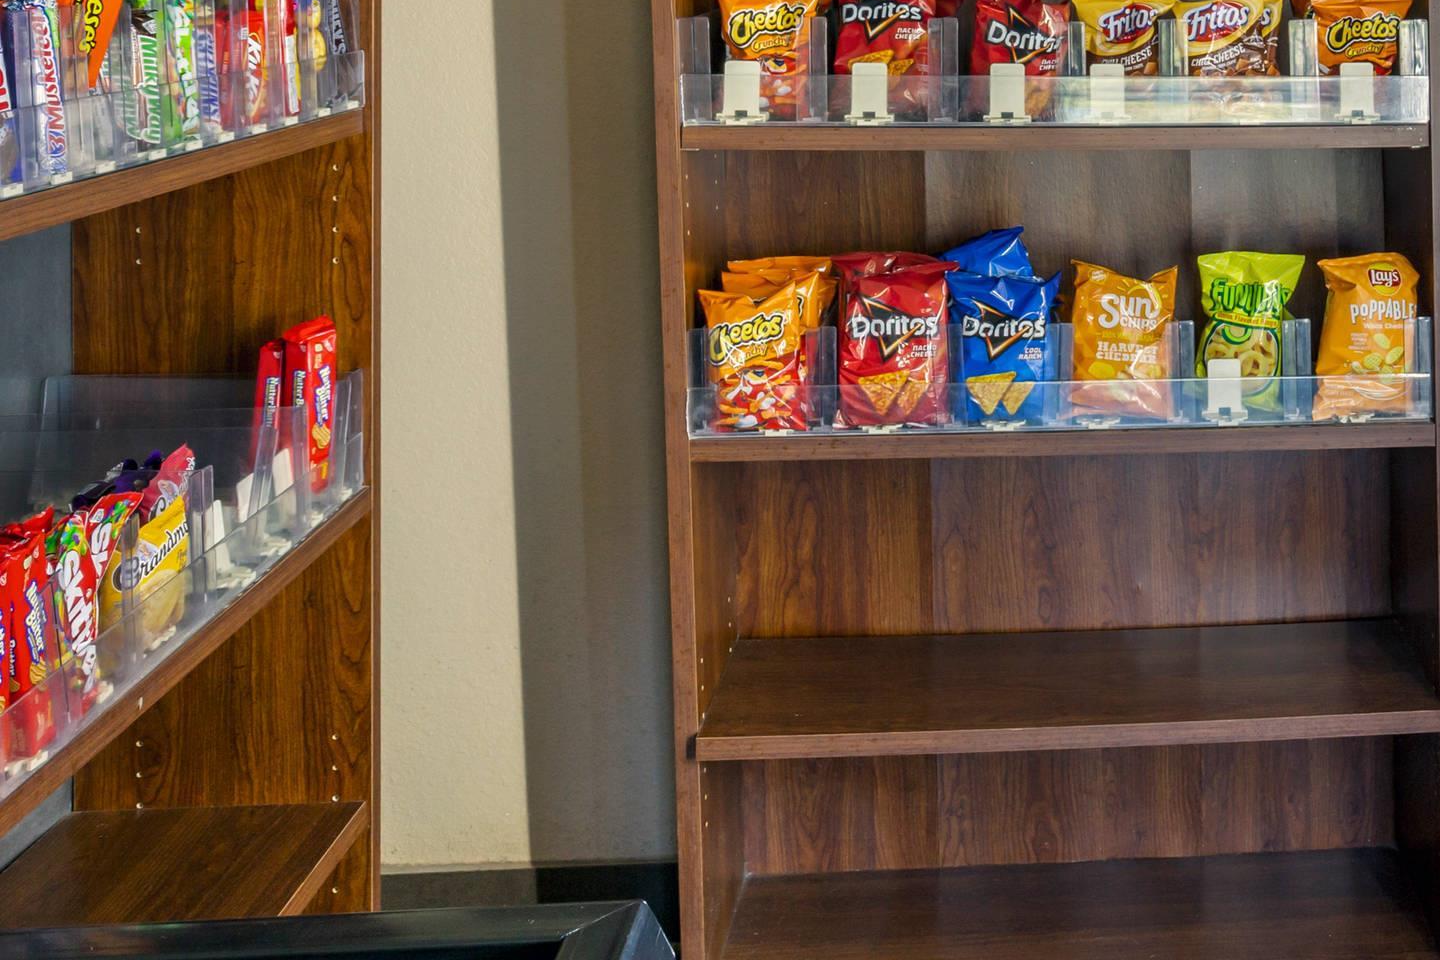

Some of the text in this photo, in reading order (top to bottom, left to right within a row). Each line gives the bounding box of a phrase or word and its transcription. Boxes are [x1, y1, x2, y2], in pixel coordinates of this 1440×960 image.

[842, 3, 922, 23] Doritos
[1101, 4, 1158, 42] Fritos
[1183, 4, 1250, 41] Fritos
[729, 3, 805, 48] Cheetos
[1326, 11, 1401, 53] Cheetos
[1121, 46, 1153, 66] CHEESE
[1213, 43, 1246, 64] CHEESE
[1370, 269, 1400, 287] Lay's
[1350, 298, 1418, 324] POPPABLE
[709, 311, 784, 366] Cheetos
[851, 315, 939, 339] Doritos
[962, 315, 1046, 338] Doritos
[1096, 341, 1159, 352] HARVEST
